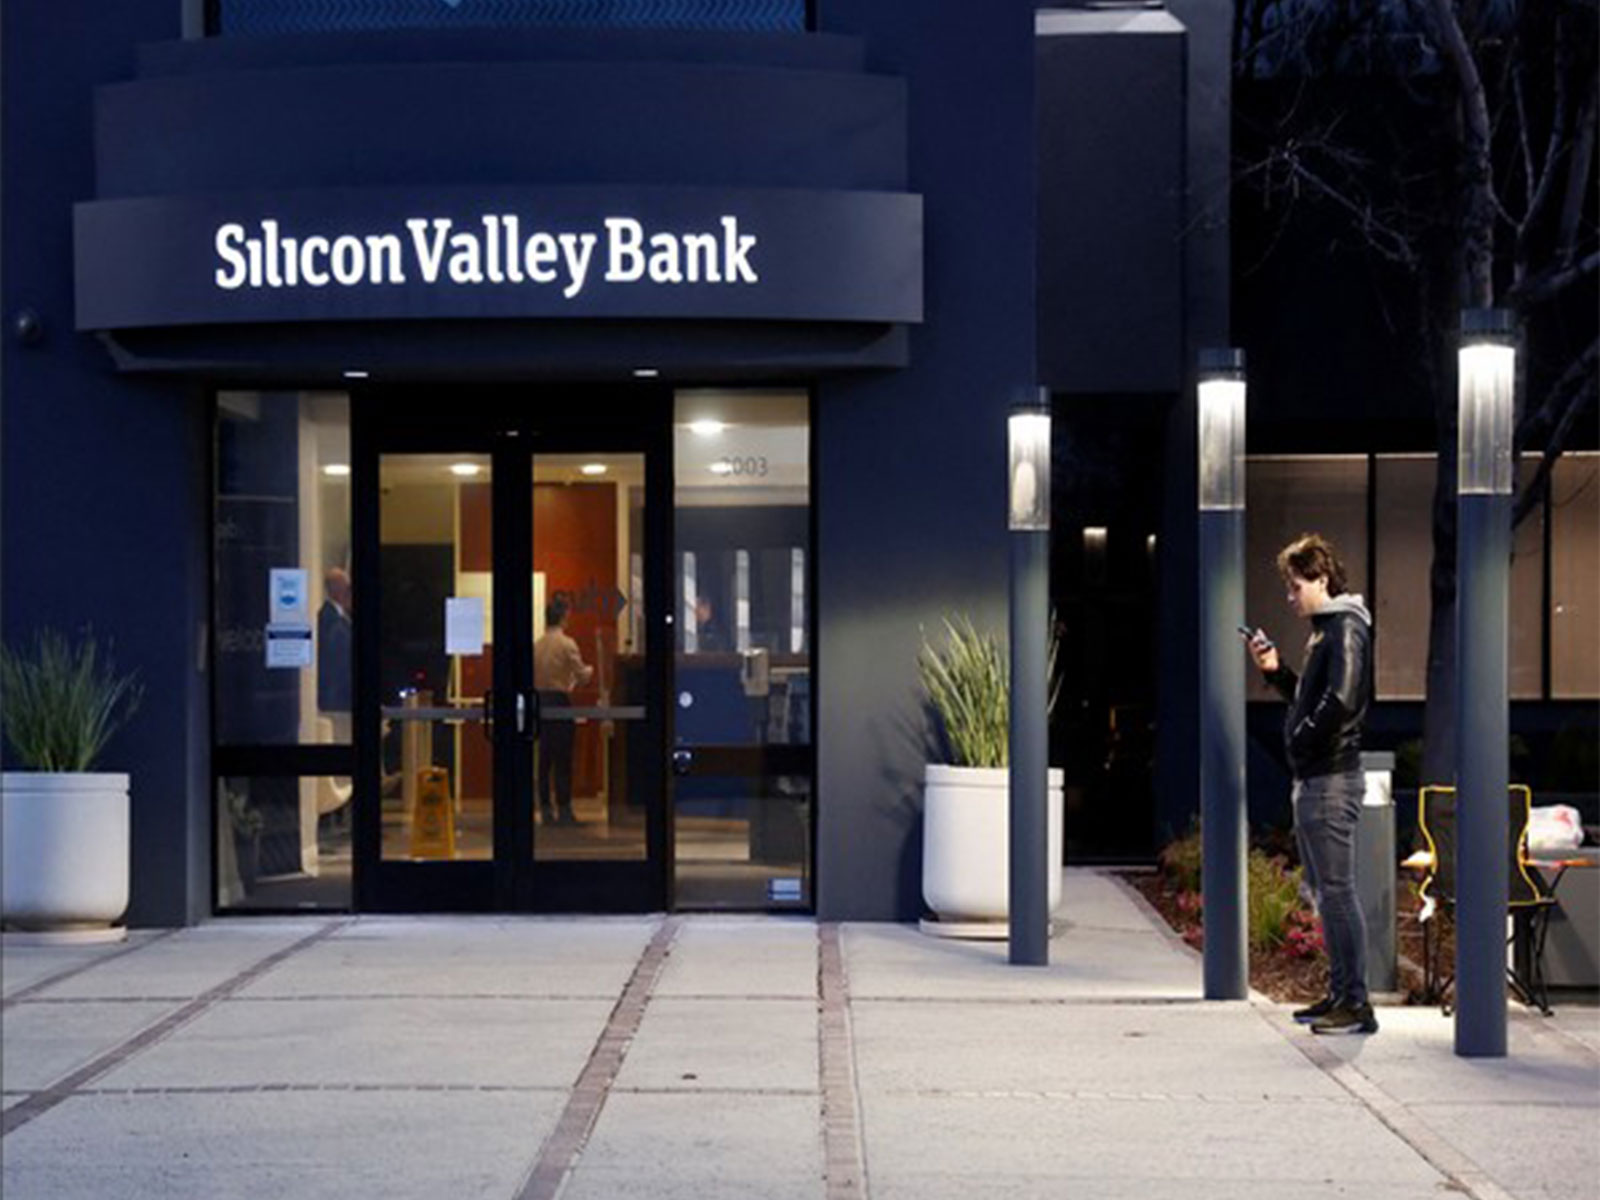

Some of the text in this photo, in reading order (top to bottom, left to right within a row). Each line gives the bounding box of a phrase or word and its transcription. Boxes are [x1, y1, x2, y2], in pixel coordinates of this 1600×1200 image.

[215, 214, 758, 298] Silicon Valley Bank
